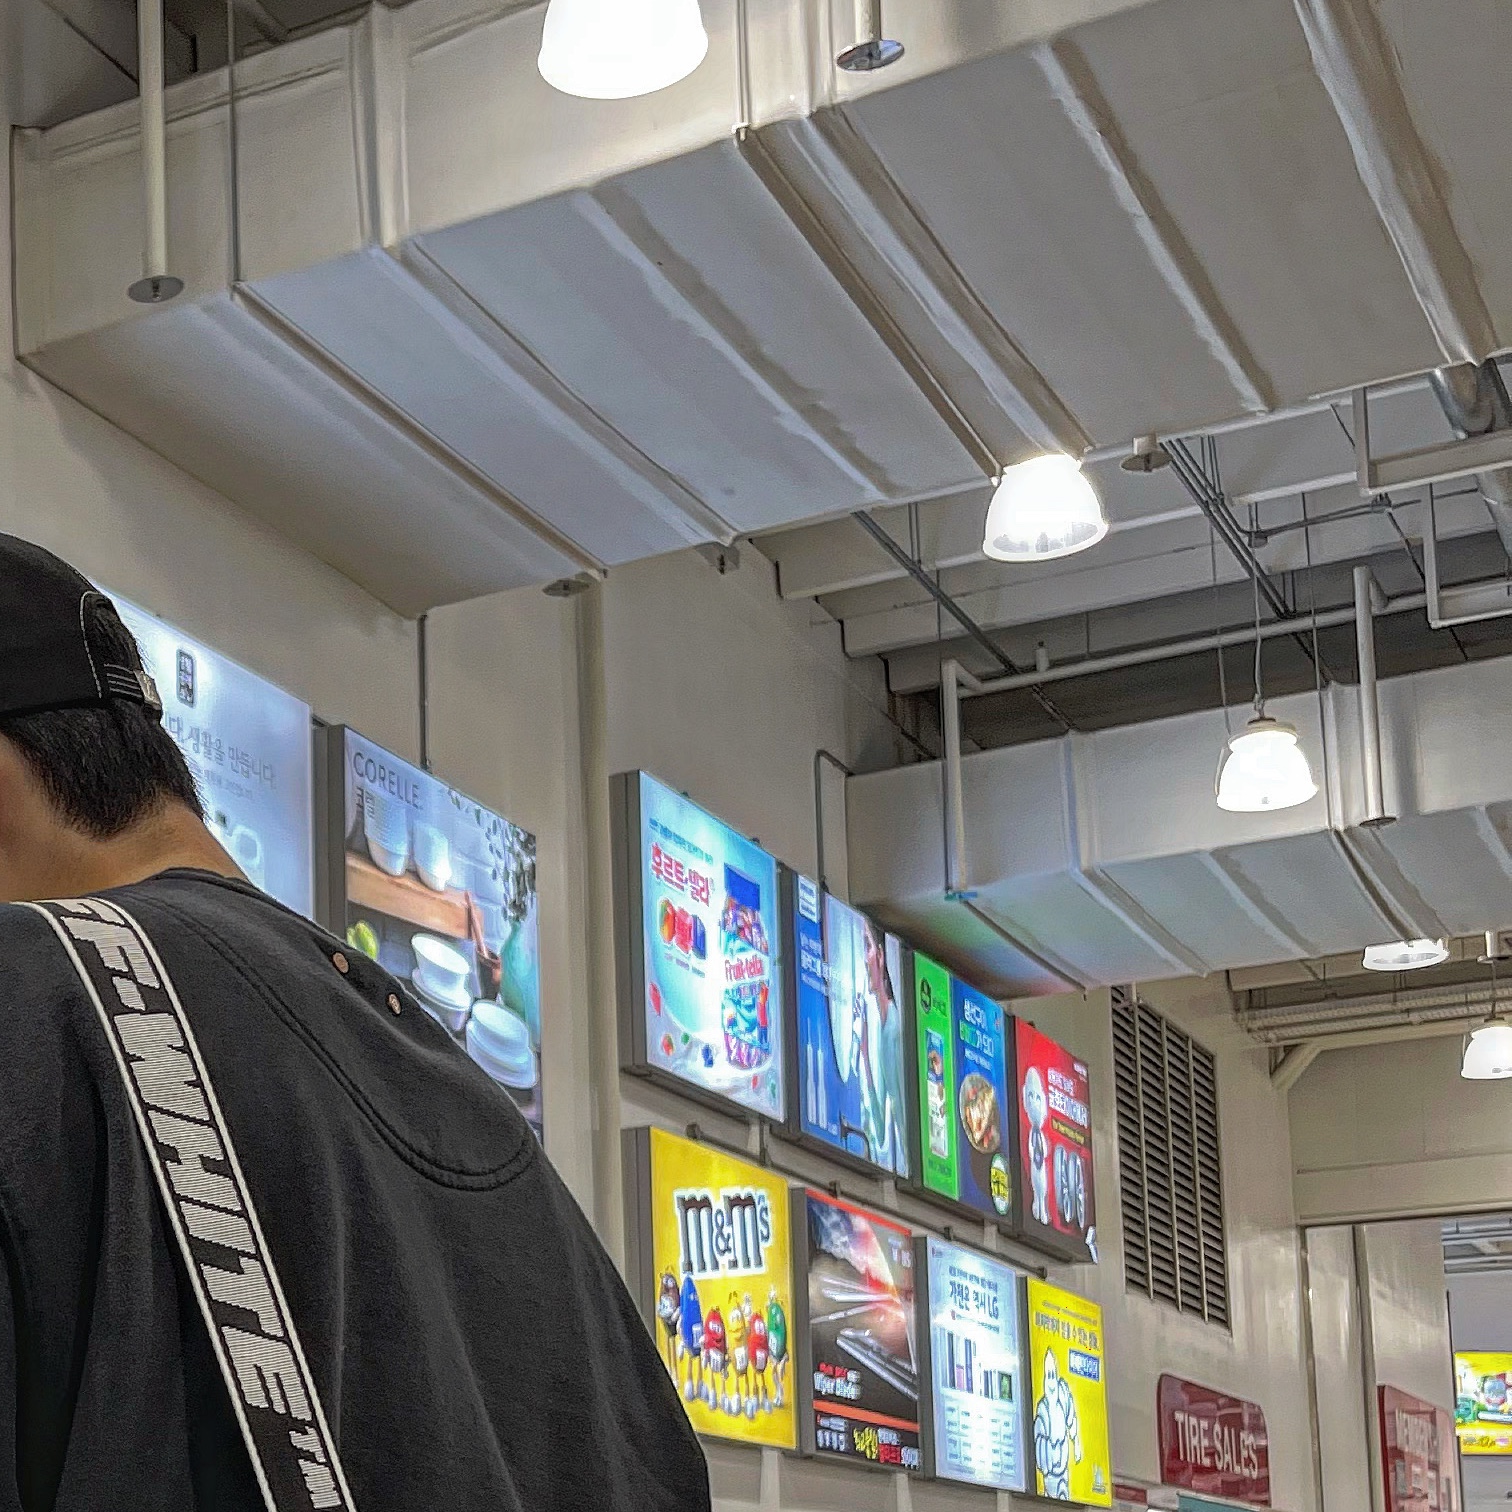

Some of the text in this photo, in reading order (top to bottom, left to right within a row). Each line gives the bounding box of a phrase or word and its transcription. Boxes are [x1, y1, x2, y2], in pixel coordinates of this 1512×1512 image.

[185, 726, 225, 766] 생활을
[353, 752, 419, 809] CORELLE
[1175, 1410, 1258, 1480] TIRE SALES
